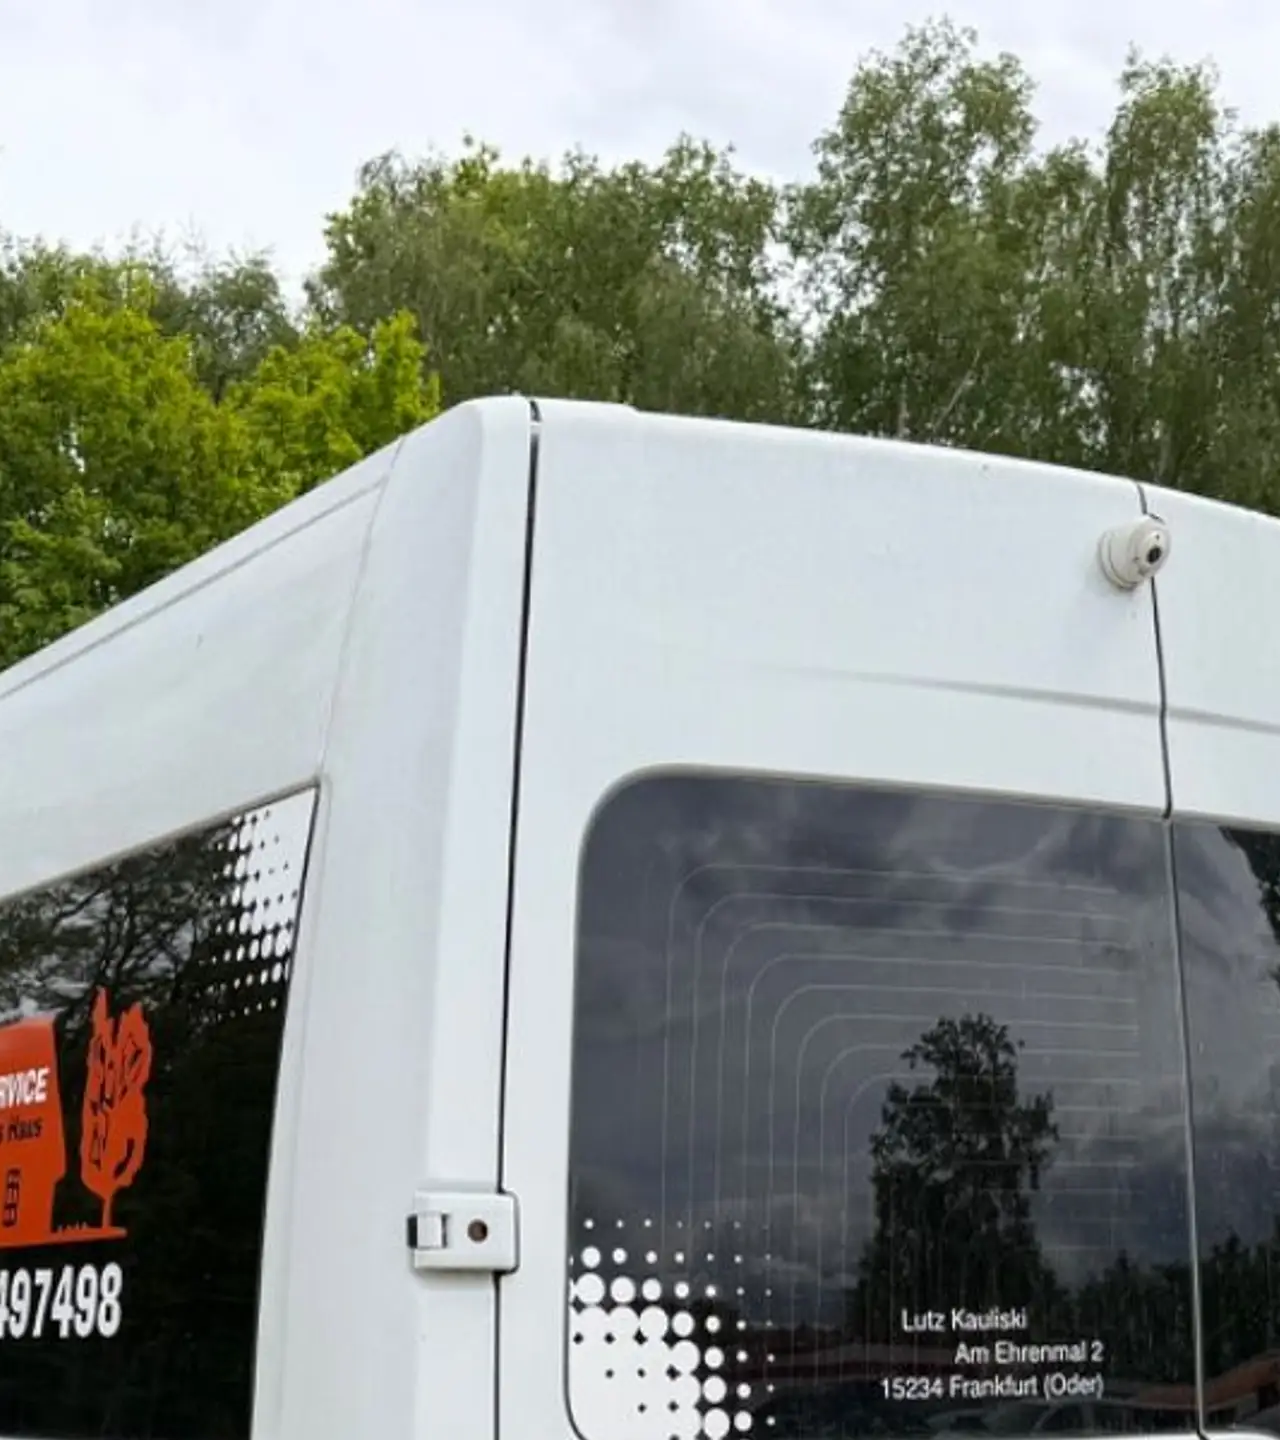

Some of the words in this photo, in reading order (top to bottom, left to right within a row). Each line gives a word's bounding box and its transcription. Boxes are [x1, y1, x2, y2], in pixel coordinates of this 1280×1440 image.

[901, 1307, 945, 1333] Lutz
[951, 1306, 1028, 1331] Kauliski
[954, 1342, 990, 1365] Am
[994, 1340, 1086, 1365] Ehrenmal
[1090, 1339, 1105, 1363] 2
[881, 1376, 944, 1400] 15234
[949, 1373, 1038, 1399] Frankfurt
[1043, 1371, 1105, 1401] (Oder)
